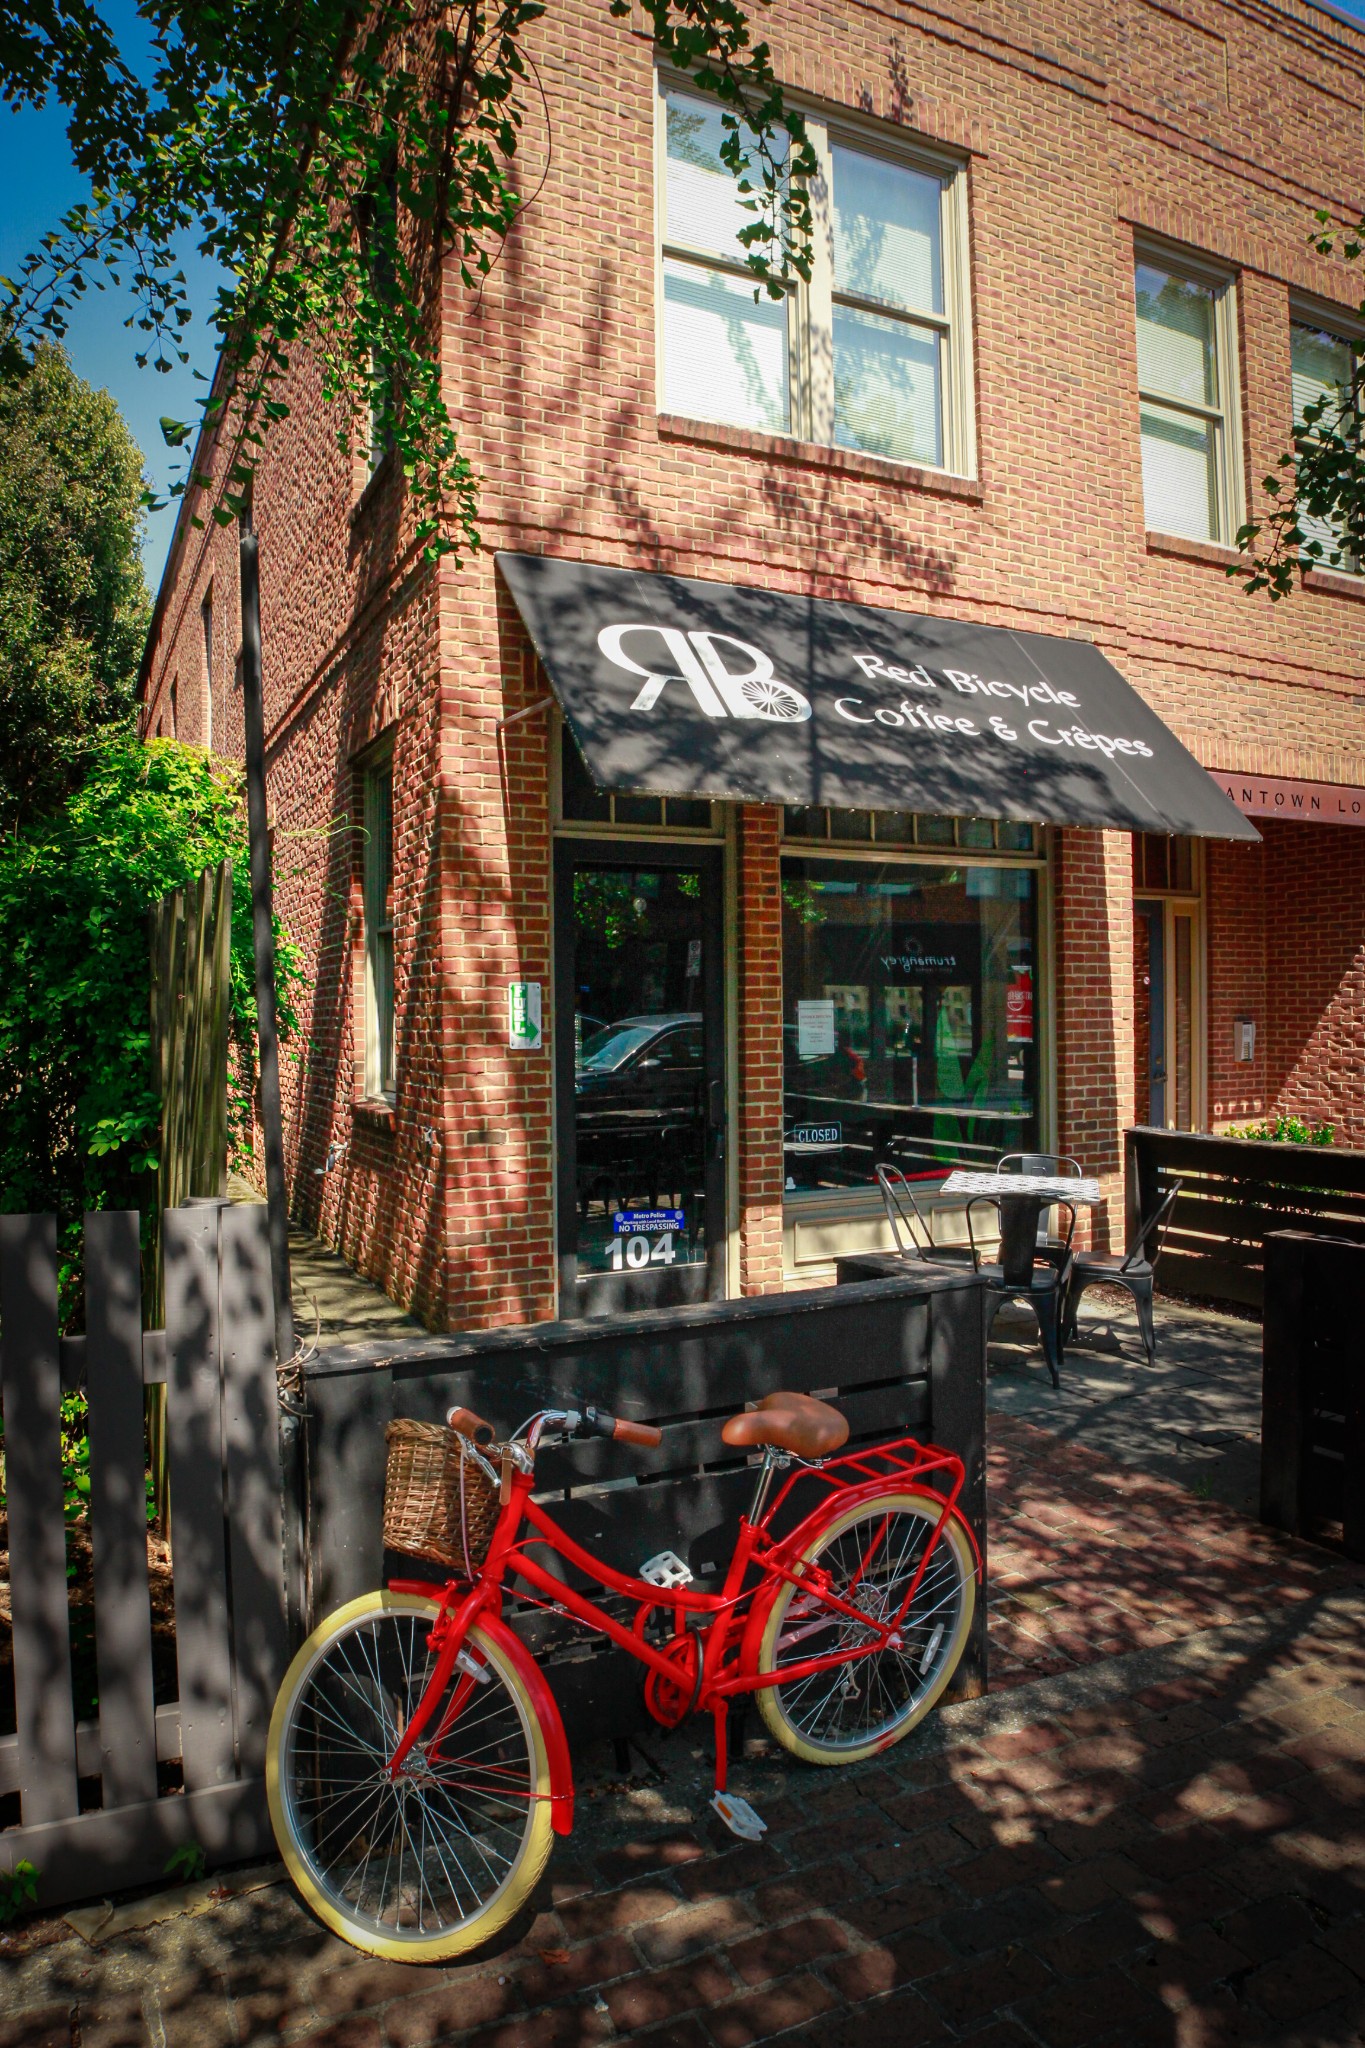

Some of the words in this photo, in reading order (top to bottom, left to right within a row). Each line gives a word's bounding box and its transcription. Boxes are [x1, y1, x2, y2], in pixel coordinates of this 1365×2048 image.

[852, 655, 936, 687] Red
[942, 669, 1081, 707] Bicycle
[834, 697, 980, 736] Coffee
[988, 716, 1018, 741] &
[1027, 719, 1154, 758] Crêpes
[513, 985, 527, 1034] FUEL
[798, 1128, 838, 1143] CLOSED
[632, 1222, 680, 1232] TRESPASSING
[605, 1232, 676, 1270] 104
